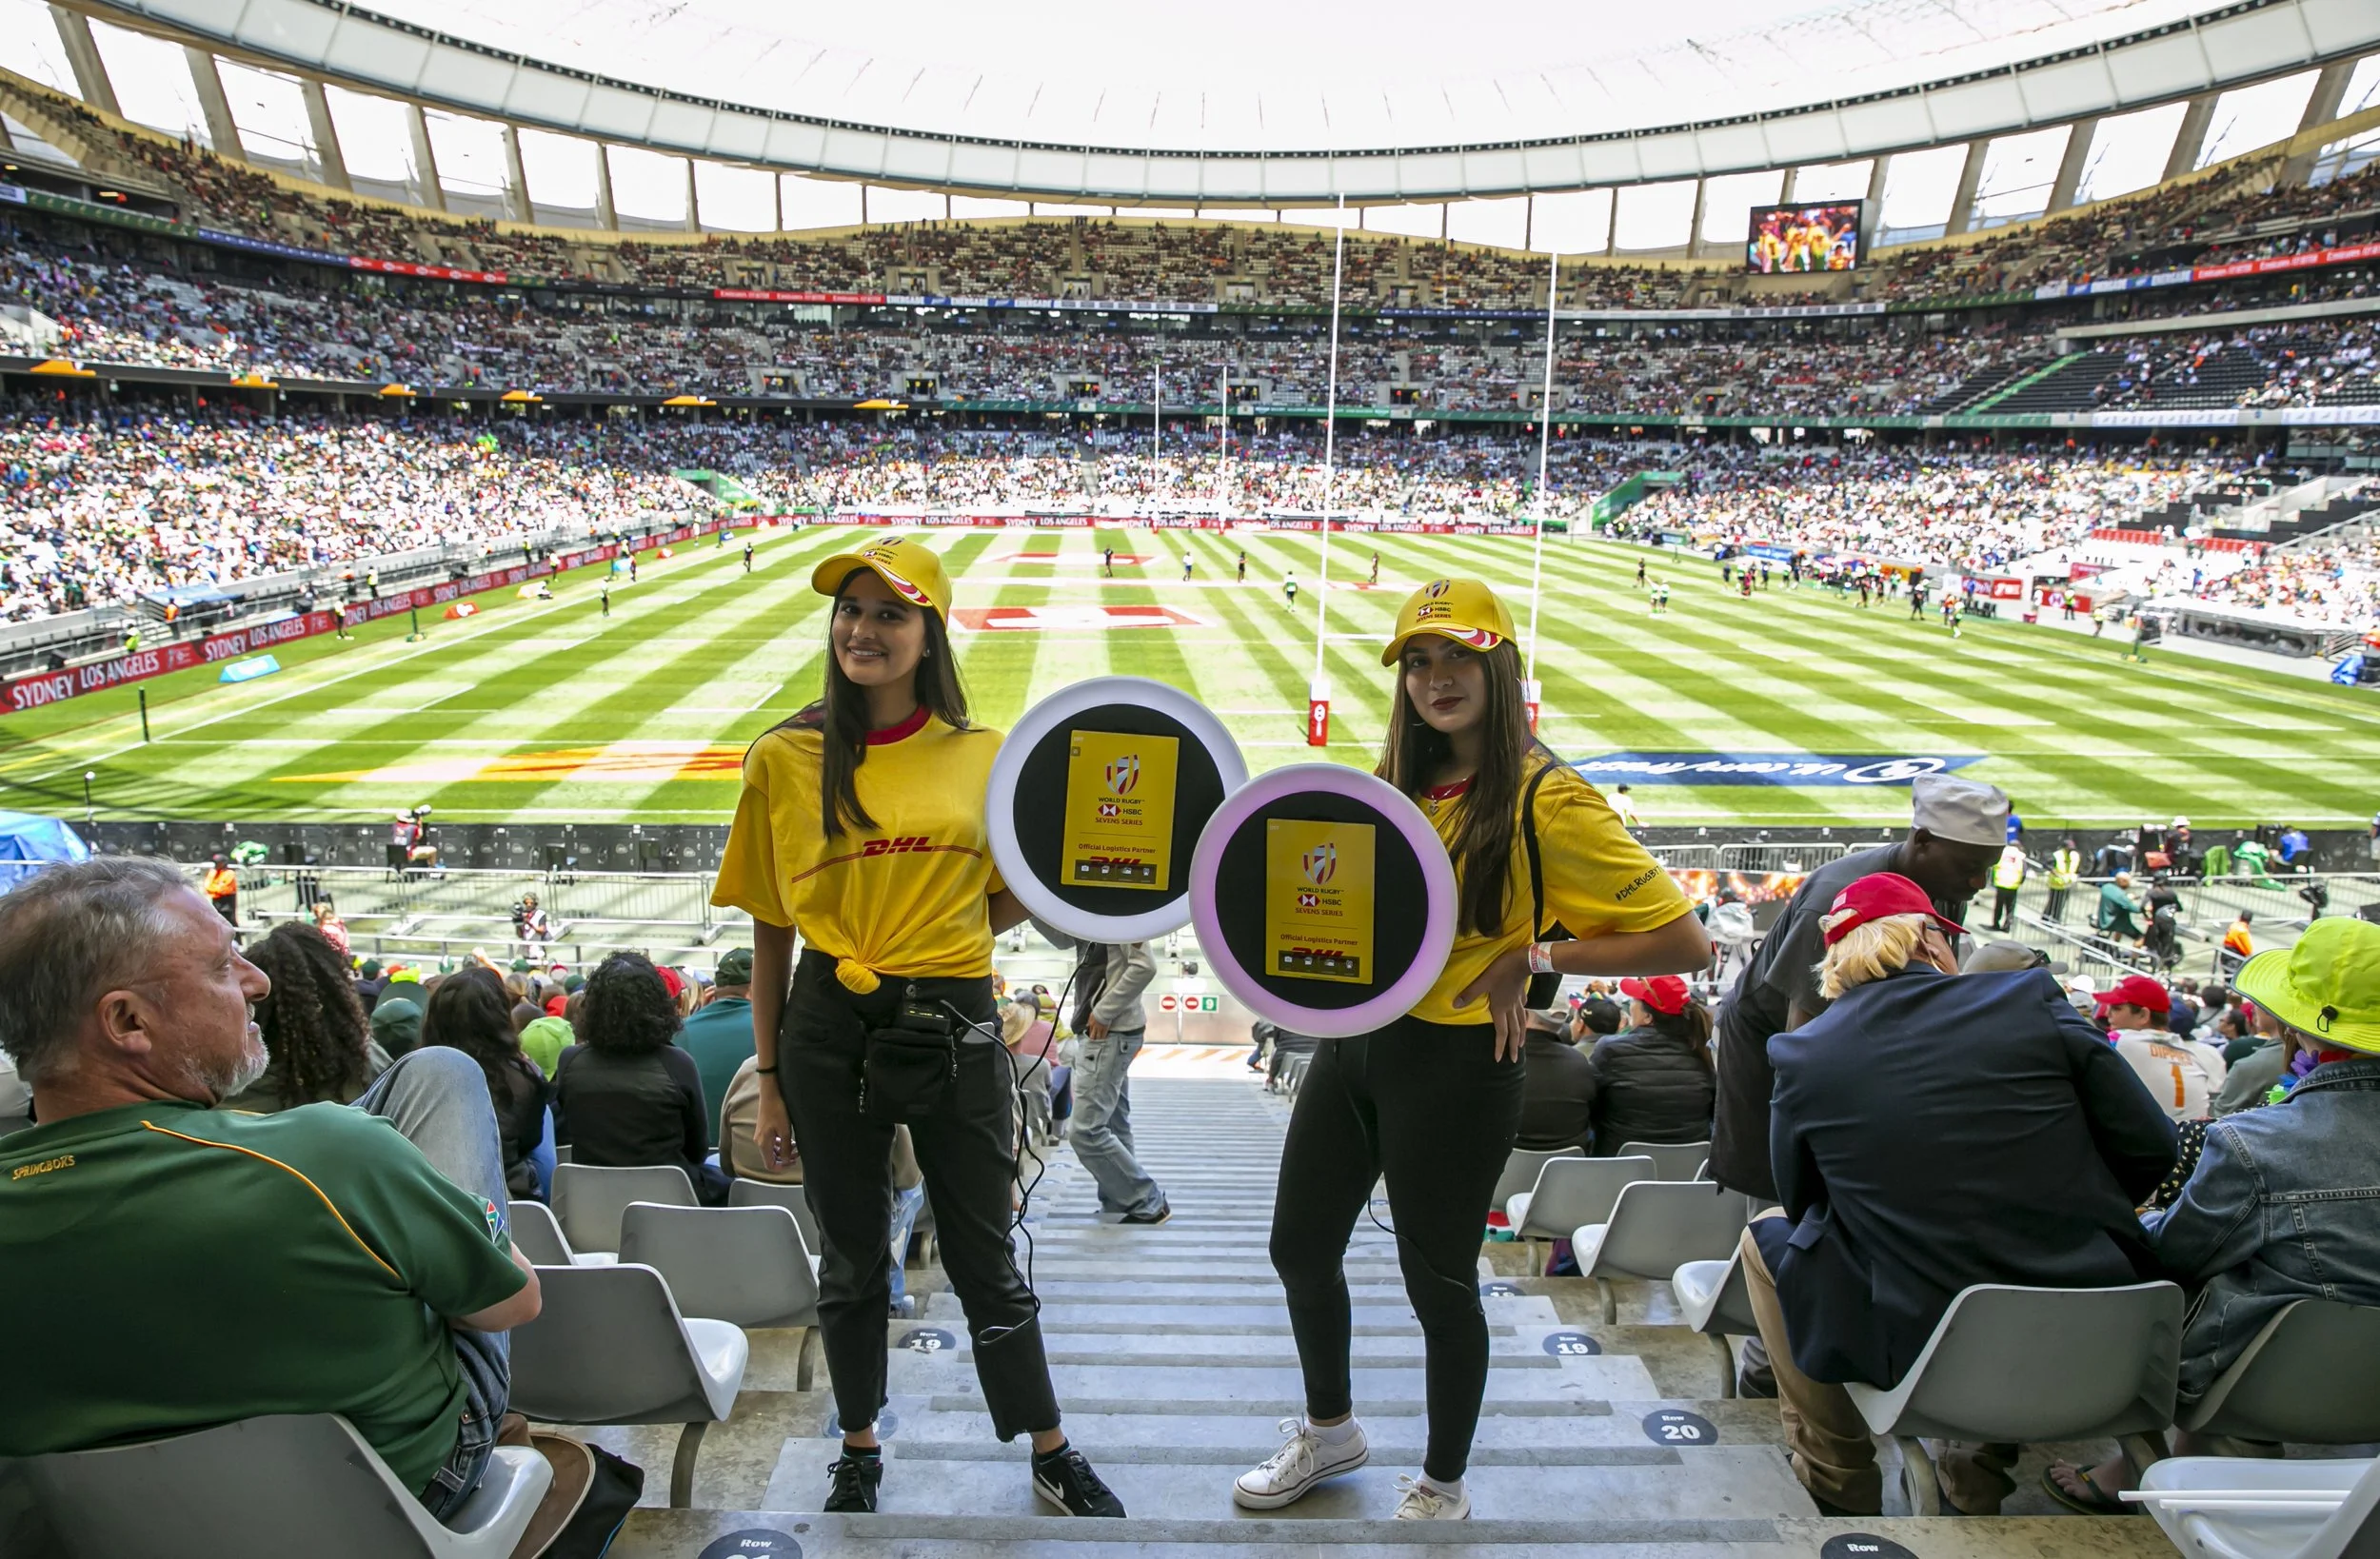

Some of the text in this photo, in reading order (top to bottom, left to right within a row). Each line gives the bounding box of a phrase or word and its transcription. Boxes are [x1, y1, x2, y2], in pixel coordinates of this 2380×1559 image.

[891, 517, 922, 525] SYDNEY
[1004, 518, 1036, 527] SYDNEY
[205, 619, 306, 662] SYDNEY LOS ANGELES
[12, 652, 160, 711] SYDNEY LOS ANGELES
[862, 837, 934, 858] DHL
[12, 1155, 75, 1180] SPRINGBOKS
[910, 1339, 942, 1350] 19
[1557, 1344, 1588, 1354] 19
[1661, 1425, 1700, 1440] 20
[740, 1539, 772, 1548] Row
[1847, 1543, 1879, 1552] Row
